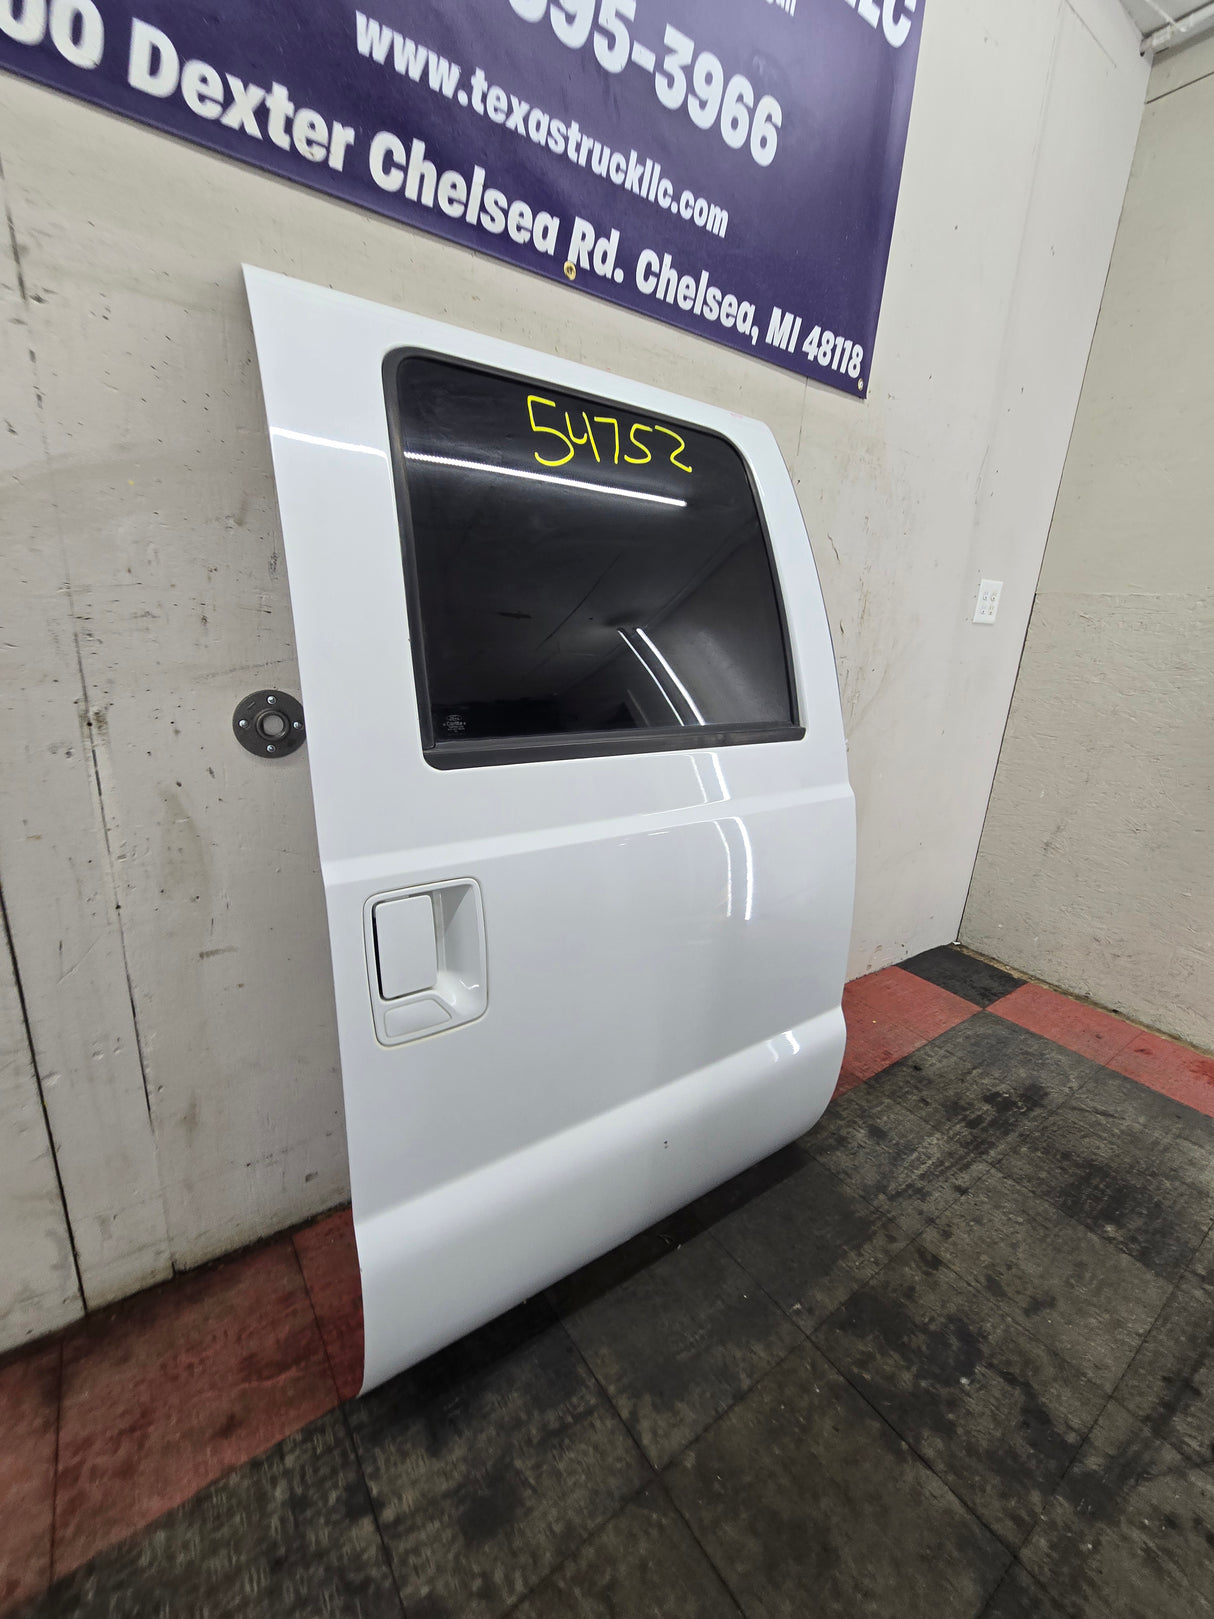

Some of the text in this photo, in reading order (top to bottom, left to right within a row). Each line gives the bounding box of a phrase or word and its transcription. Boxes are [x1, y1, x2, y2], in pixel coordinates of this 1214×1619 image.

[355, 10, 729, 238] www.texastruckllc.com
[508, 0, 783, 167] 95-3966
[128, 17, 355, 172] Dexter
[369, 131, 560, 256] Chelsea
[566, 216, 624, 283] Rd.
[635, 248, 759, 346] Chelsea,
[765, 306, 803, 353] MI
[801, 325, 864, 379] 48118
[527, 395, 692, 473] 54752
